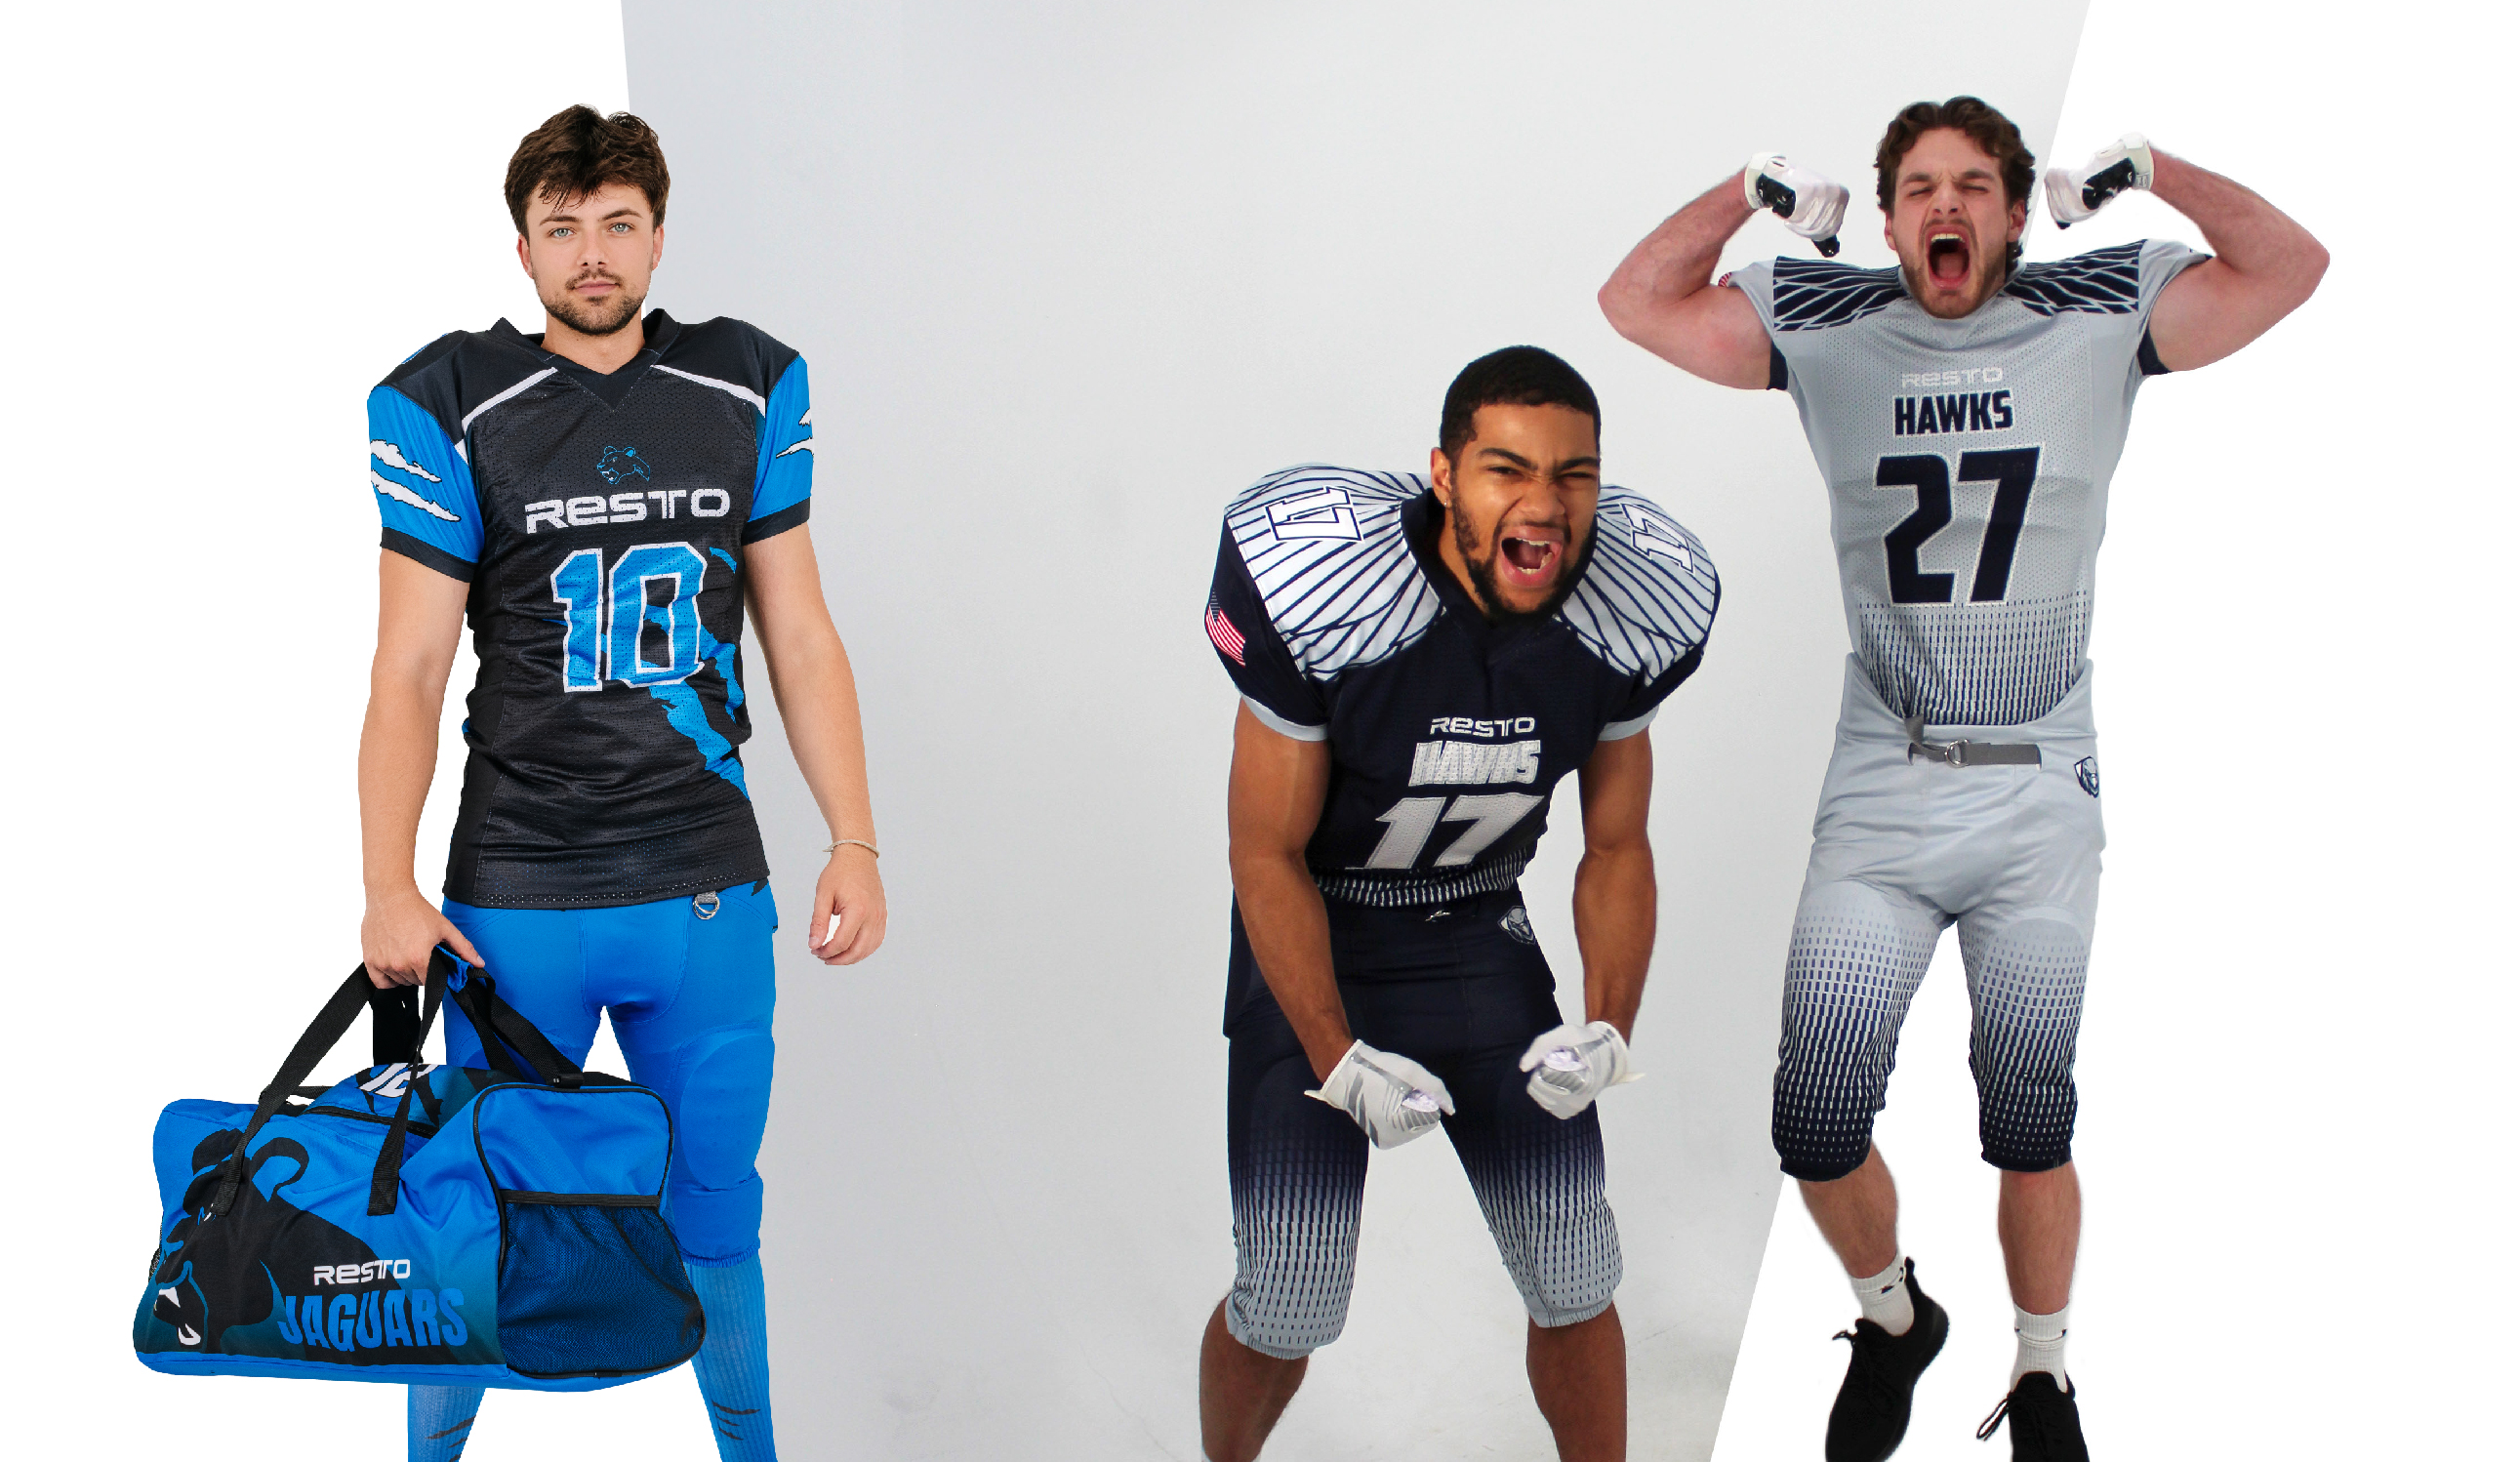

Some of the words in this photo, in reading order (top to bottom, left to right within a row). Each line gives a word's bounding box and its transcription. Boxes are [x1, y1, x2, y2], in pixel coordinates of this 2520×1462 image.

[1892, 388, 2014, 438] HAWKS
[1265, 486, 1364, 543] 17
[1620, 503, 1695, 575] 17
[1873, 442, 2046, 606] 27
[550, 542, 708, 693] 10
[1364, 792, 1544, 869] 17
[277, 1287, 467, 1352] JAGUARS
